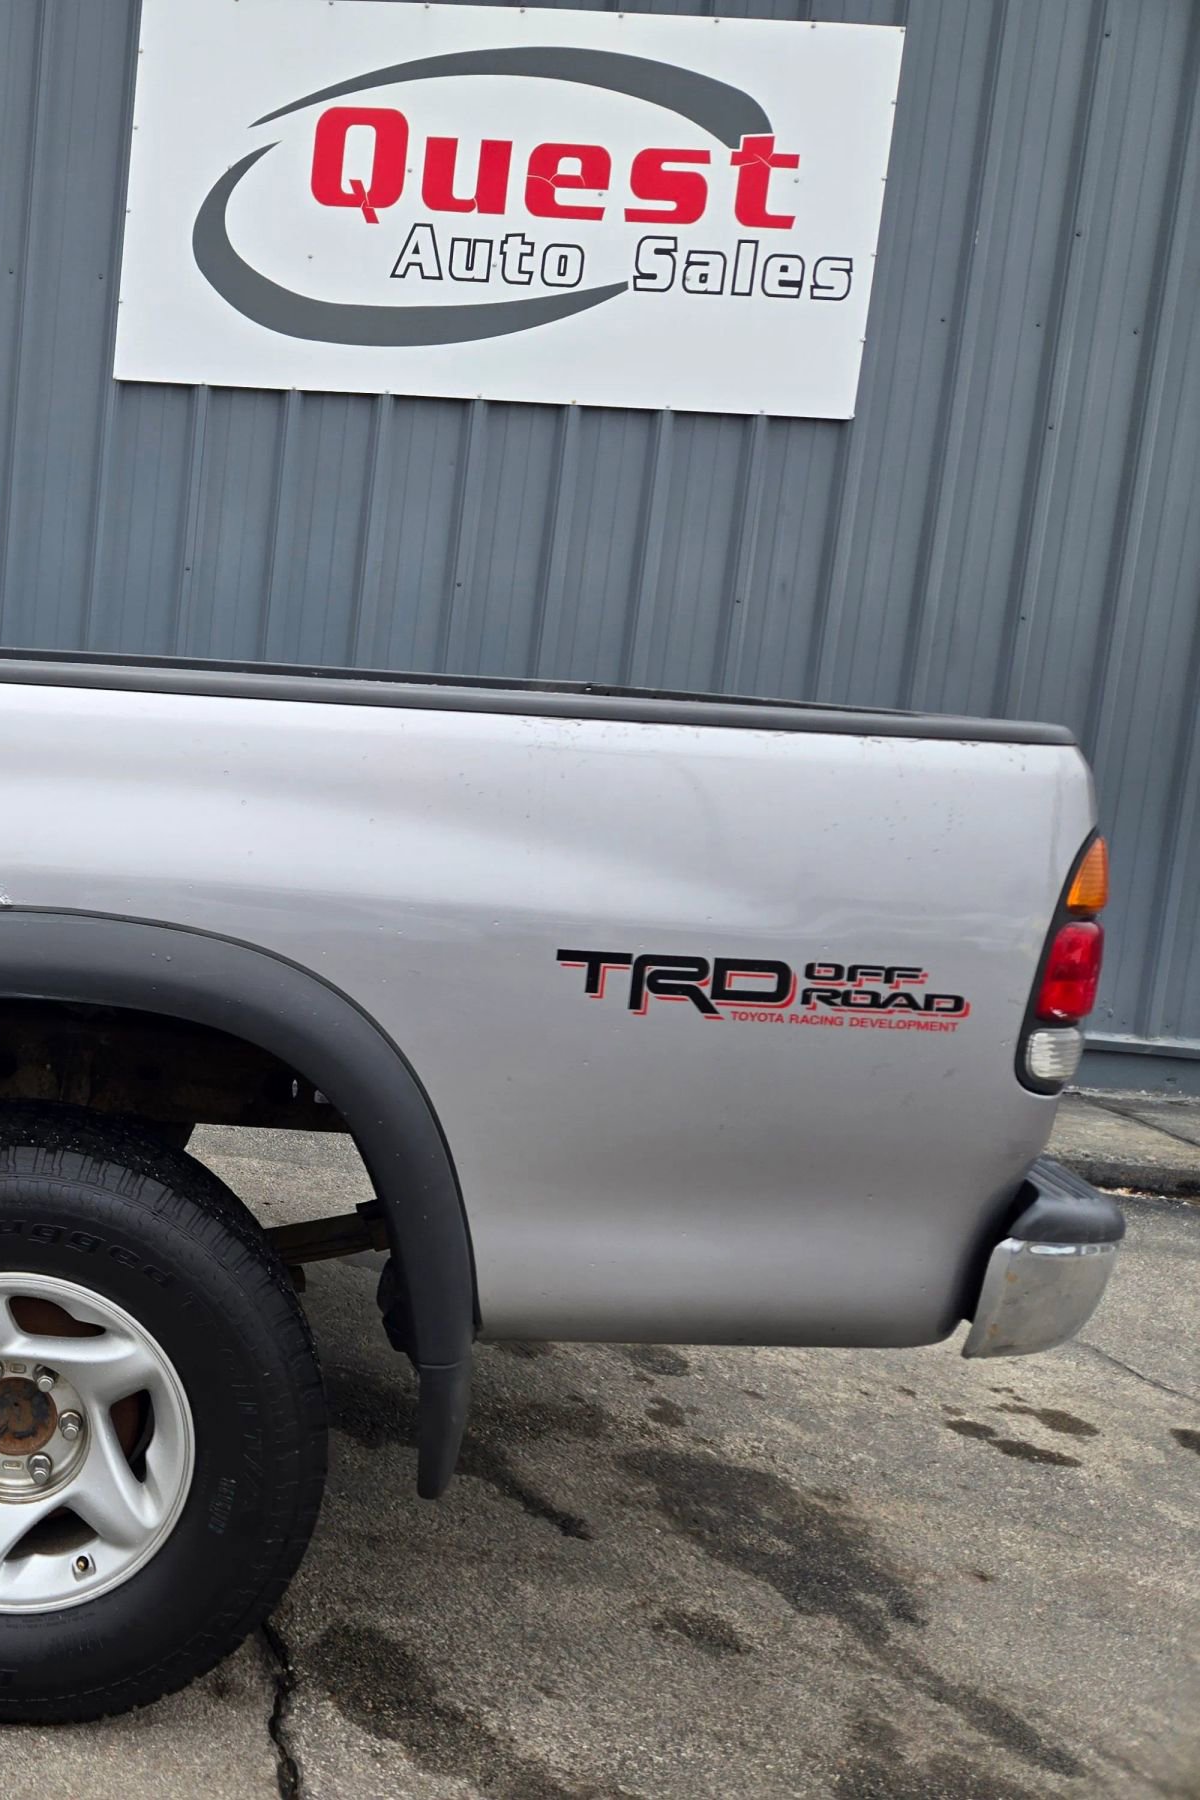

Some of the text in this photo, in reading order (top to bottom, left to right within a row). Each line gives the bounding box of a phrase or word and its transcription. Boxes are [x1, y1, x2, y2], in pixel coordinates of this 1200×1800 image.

[310, 106, 800, 230] Quest
[390, 223, 854, 301] Auto Sales
[556, 949, 797, 1020] TRD
[804, 962, 928, 989] OFF
[730, 1010, 959, 1033] TOYOTA RACING DEVELOPMENT
[801, 987, 971, 1018] ROAD
